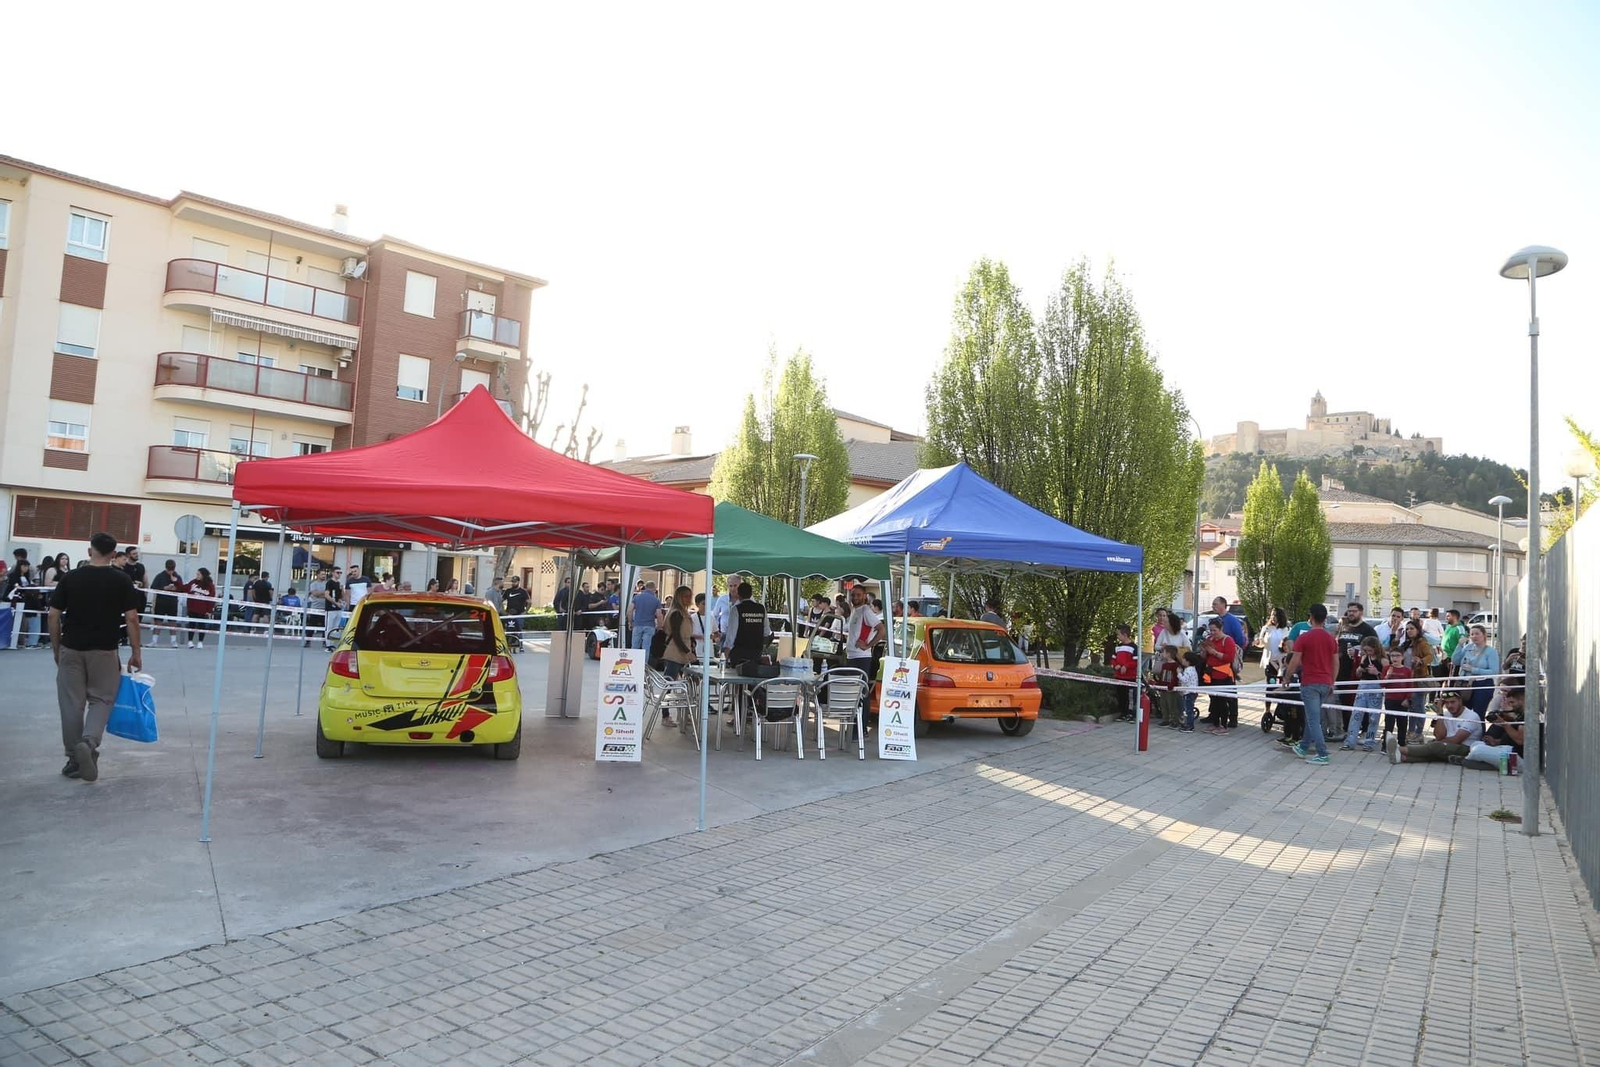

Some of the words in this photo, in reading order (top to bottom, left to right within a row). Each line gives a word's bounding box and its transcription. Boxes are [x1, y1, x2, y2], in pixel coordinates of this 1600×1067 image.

[469, 609, 487, 621] 21
[605, 683, 637, 692] CEM
[355, 708, 382, 719] MUSIC
[396, 699, 419, 709] TIME
